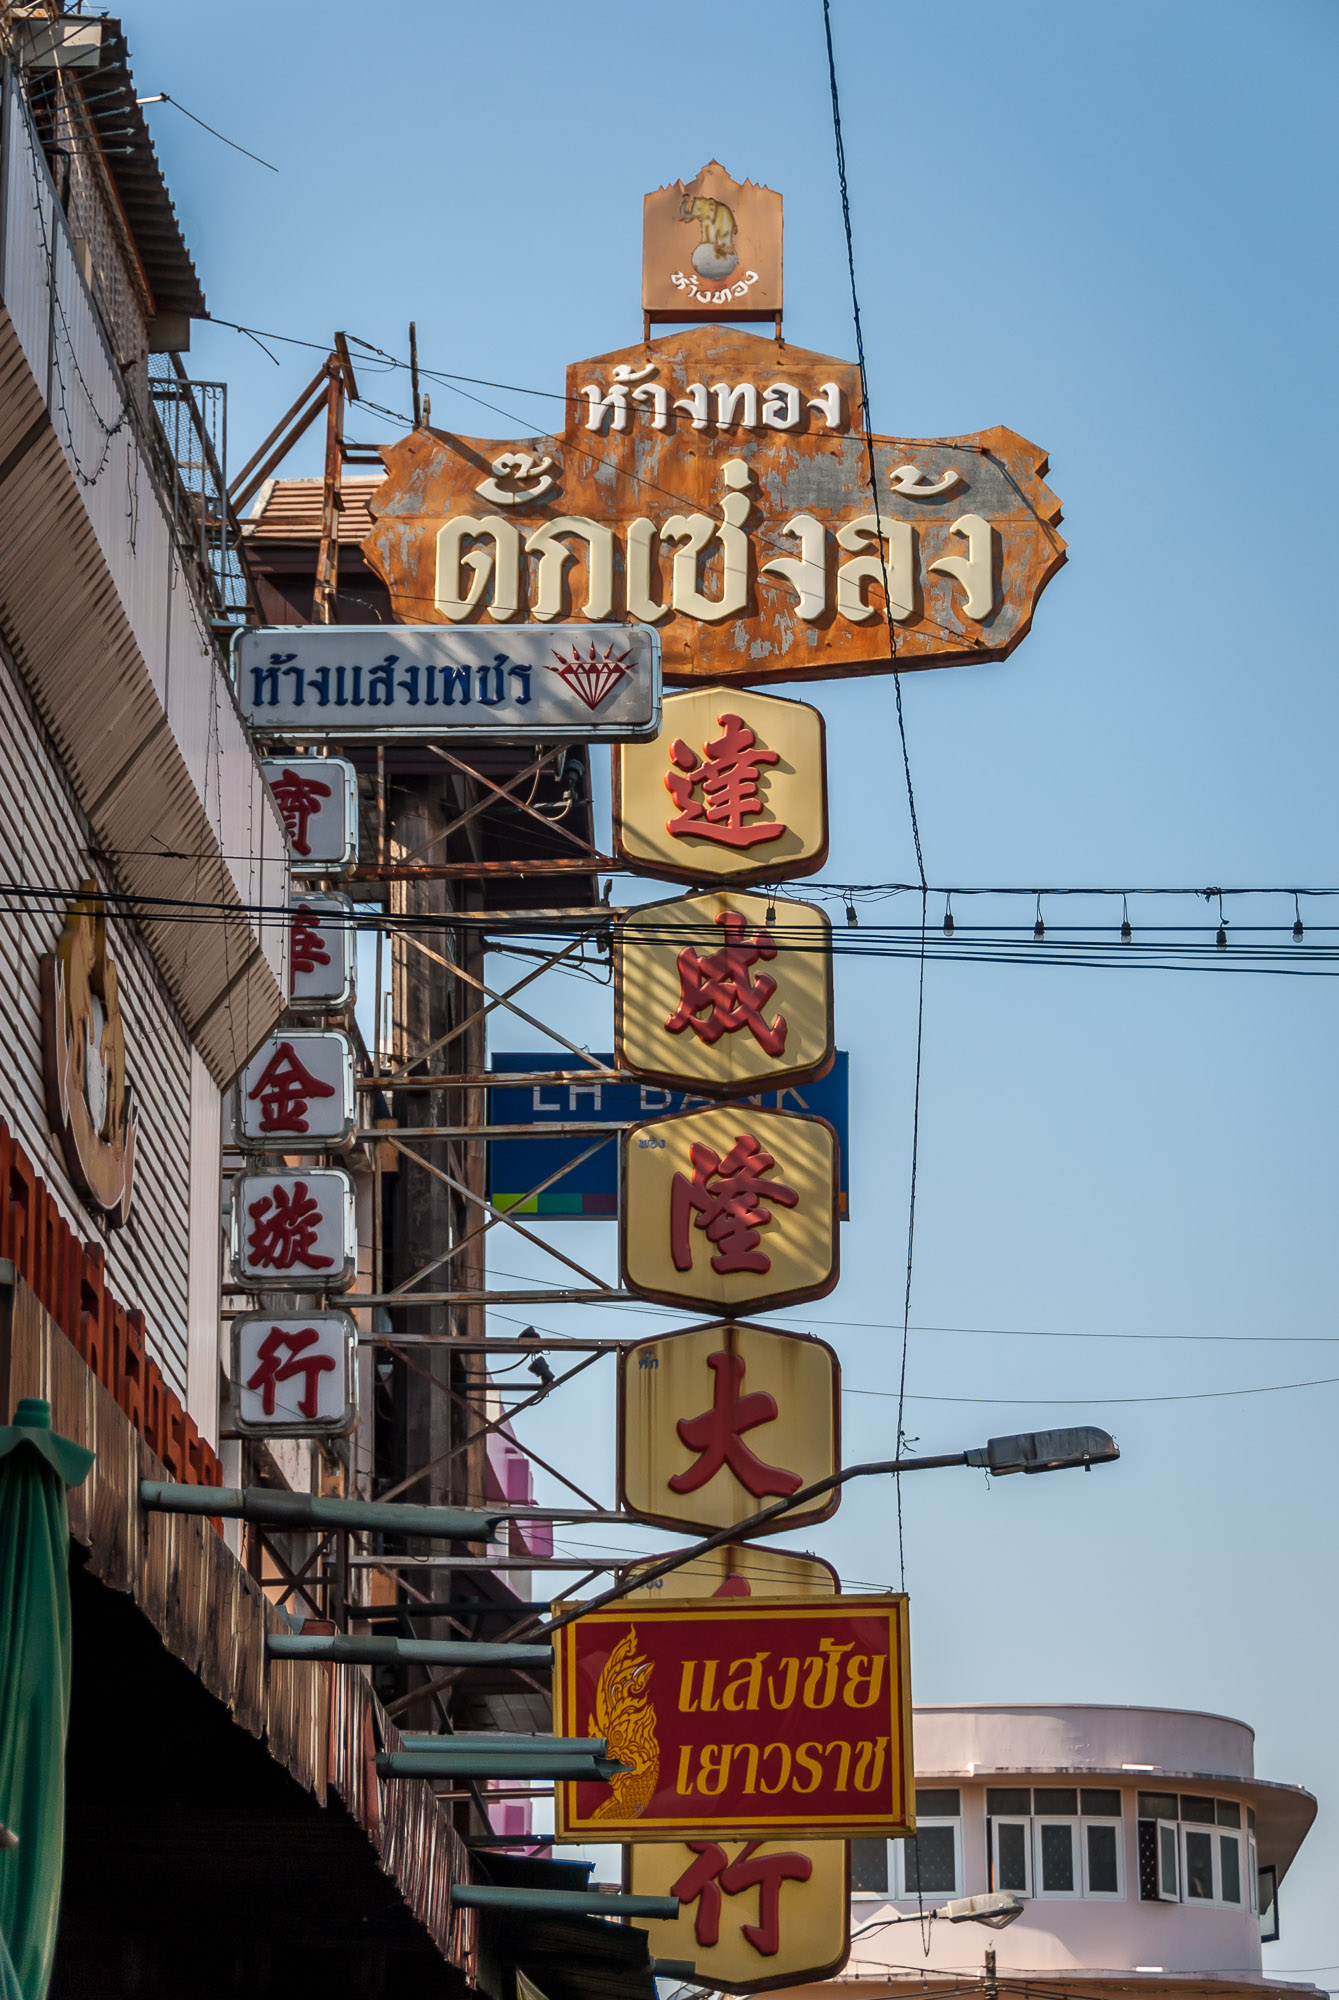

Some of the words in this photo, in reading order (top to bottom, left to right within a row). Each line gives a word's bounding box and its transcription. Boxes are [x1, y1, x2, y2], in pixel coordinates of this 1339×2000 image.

[580, 363, 841, 432] ห้างทอง
[249, 652, 534, 707] ห้างแสงเพชร
[676, 1637, 888, 1713] แสงชัย
[675, 1736, 891, 1796] เยาวราช
